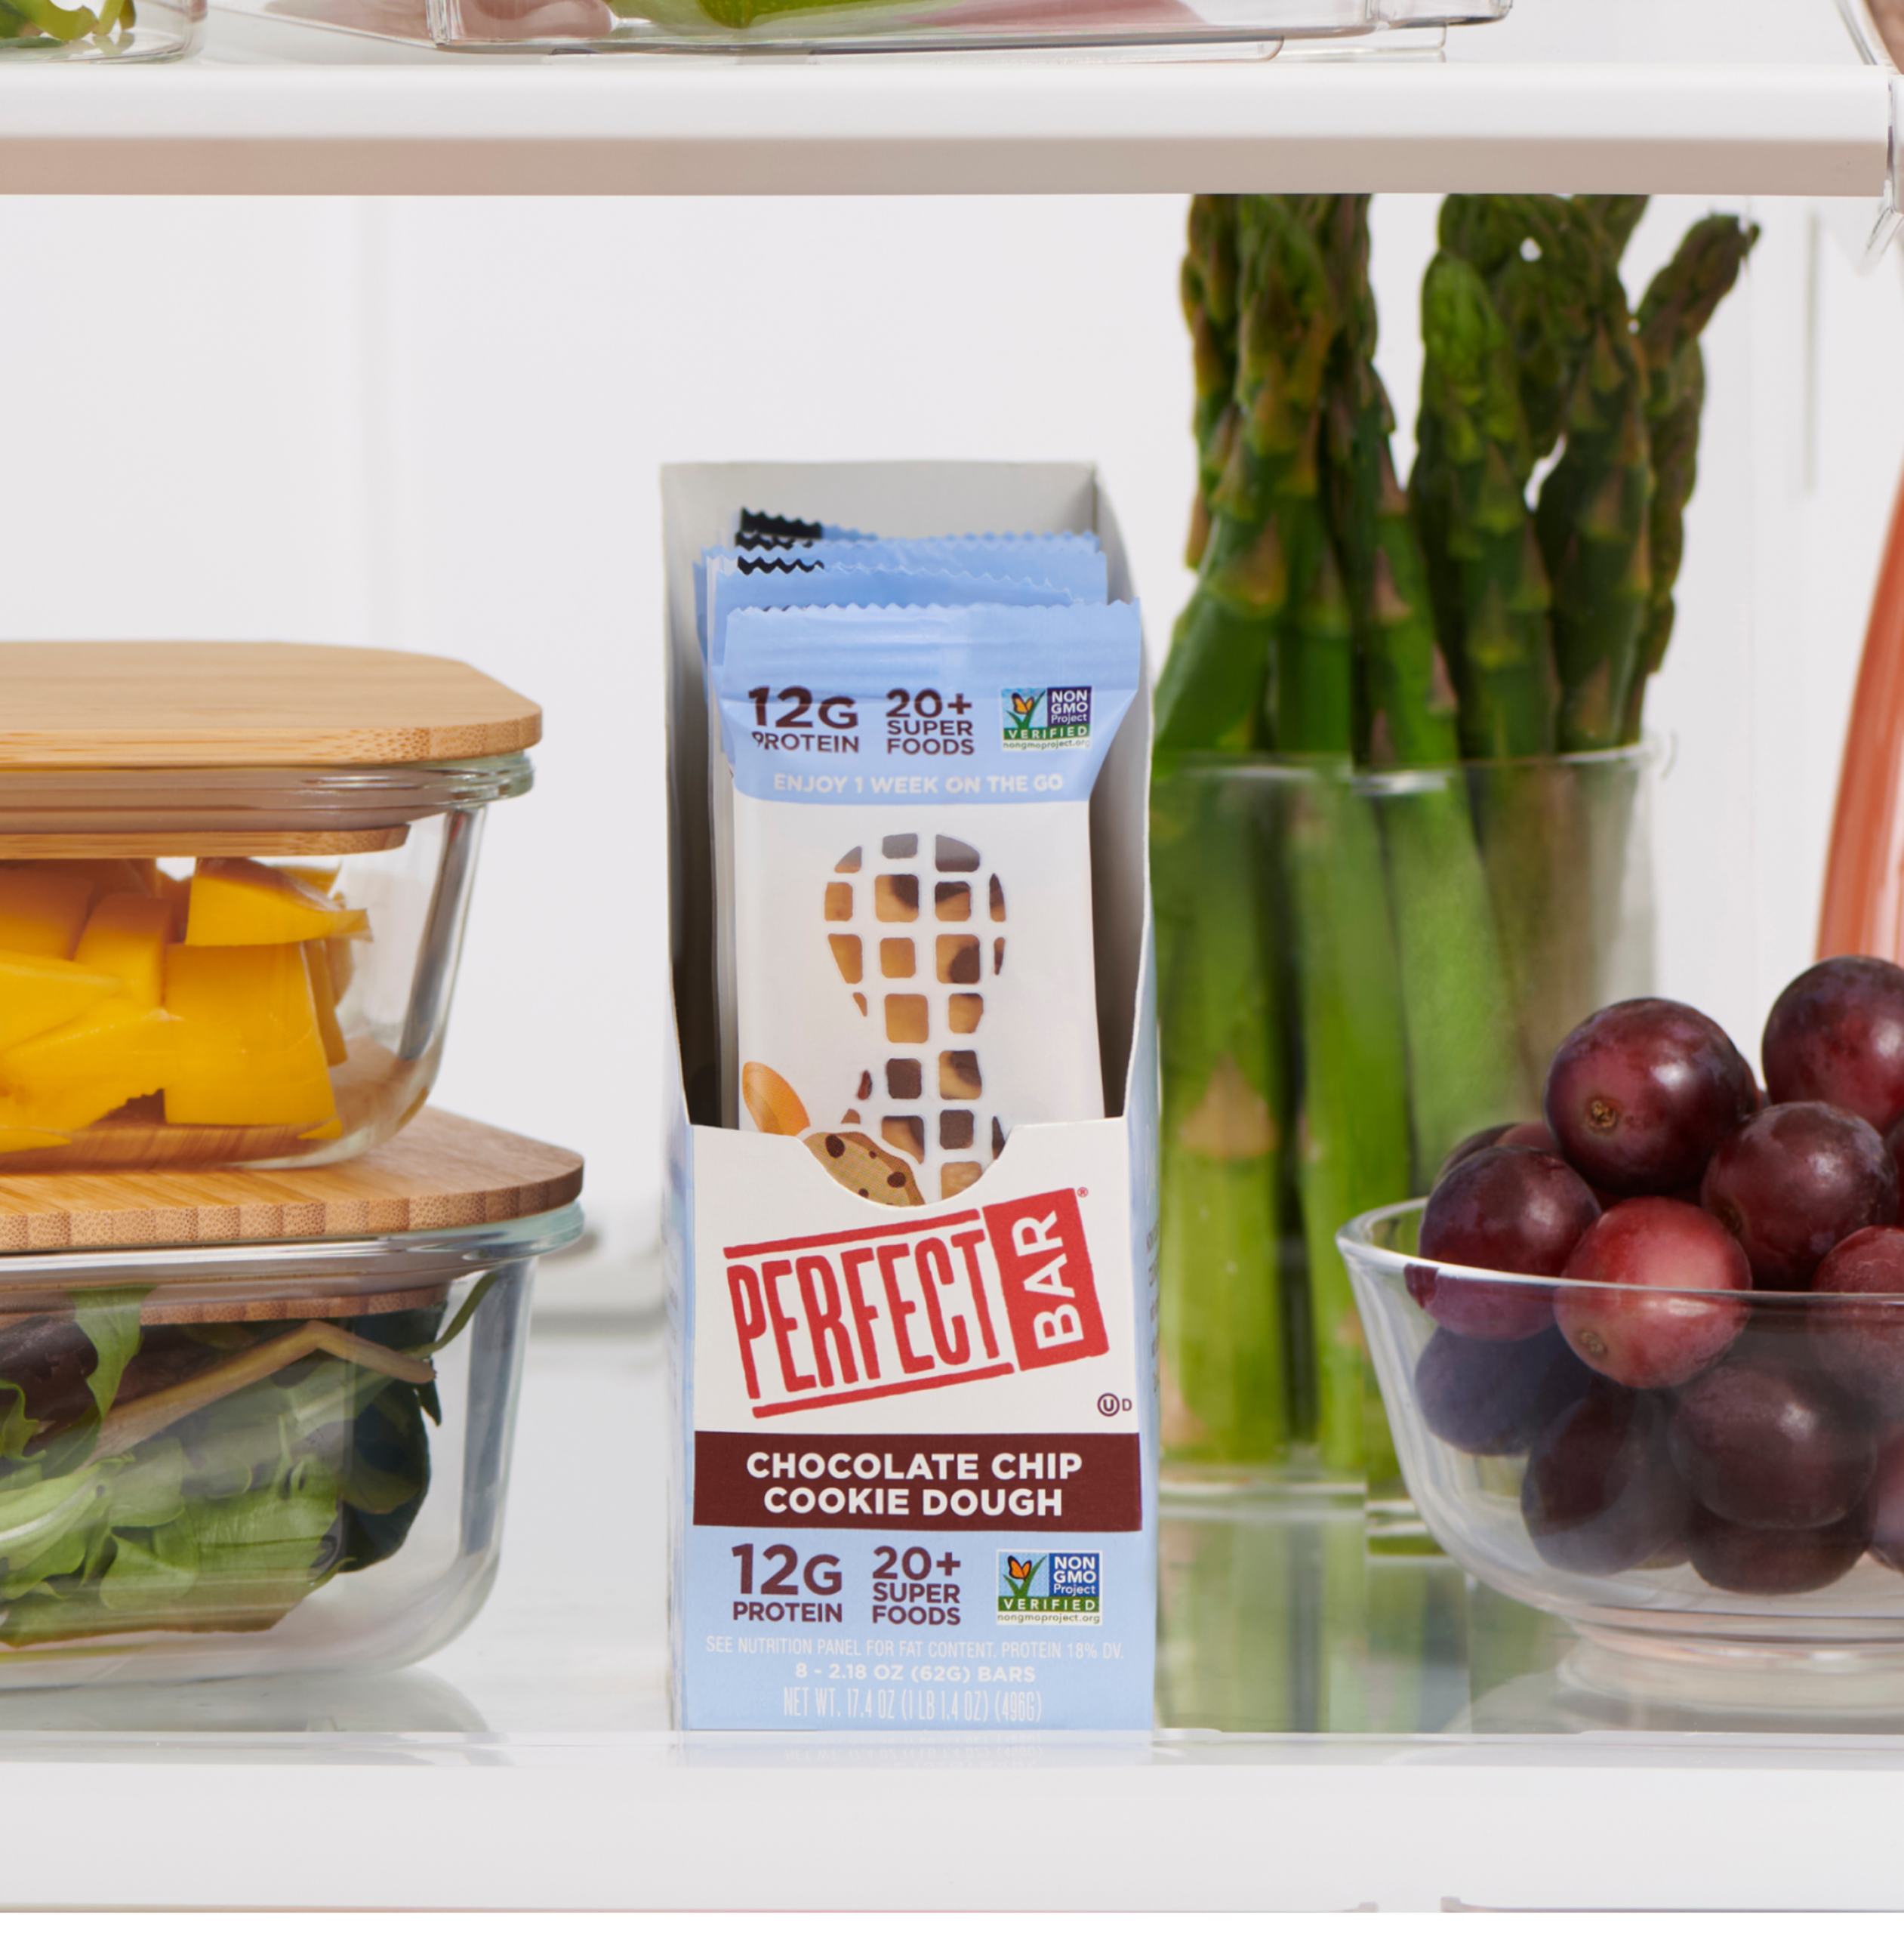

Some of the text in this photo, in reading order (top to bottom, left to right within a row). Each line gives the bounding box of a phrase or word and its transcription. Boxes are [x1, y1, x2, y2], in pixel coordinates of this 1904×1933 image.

[886, 687, 972, 718] 20+
[1052, 689, 1088, 703] NON
[748, 686, 858, 729] 12G
[1051, 702, 1089, 714] GMO
[887, 720, 974, 736] SUPER
[1051, 714, 1088, 725] Project
[751, 731, 859, 754] PROTEIN
[1008, 726, 1088, 739] VERIFIED
[887, 738, 975, 756] FOODS
[1003, 738, 1090, 750] nongmoproject.org
[774, 773, 1063, 794] ENJOY 1 WEEK ON THE GO
[1011, 1210, 1084, 1350] BAR
[727, 1229, 1000, 1400] PERFECT
[747, 1451, 1083, 1481] CHOCOLATE CHIP
[764, 1488, 1063, 1517] COOKIE DOUGH
[731, 1543, 843, 1596] 12G
[873, 1545, 961, 1581] 20+
[1054, 1556, 1095, 1570] NON
[1053, 1571, 1097, 1584] GMO
[873, 1582, 961, 1604] SUPER
[1053, 1583, 1096, 1597] Project
[733, 1601, 843, 1623] PROTEIN
[1003, 1598, 1096, 1611] VERIFIED
[873, 1605, 961, 1626] FOODS
[997, 1613, 1101, 1625] nongmoproject.org
[706, 1635, 1124, 1660] SEE NUTRITION PANEL FOR FAT CONTENT. PROTEIN 18% DV.
[795, 1662, 808, 1679] 8
[828, 1663, 867, 1679] 2.18
[873, 1664, 904, 1681] OZ
[910, 1665, 971, 1684] (62G)
[978, 1666, 1036, 1682] BARS
[784, 1687, 809, 1717] NET
[815, 1687, 841, 1717] WT.
[847, 1688, 873, 1719] 17.4
[878, 1688, 895, 1719] OZ
[919, 1690, 935, 1720] LB
[941, 1690, 959, 1721] 1.4
[964, 1690, 989, 1722] OZ)
[995, 1690, 1042, 1722] (496G)
